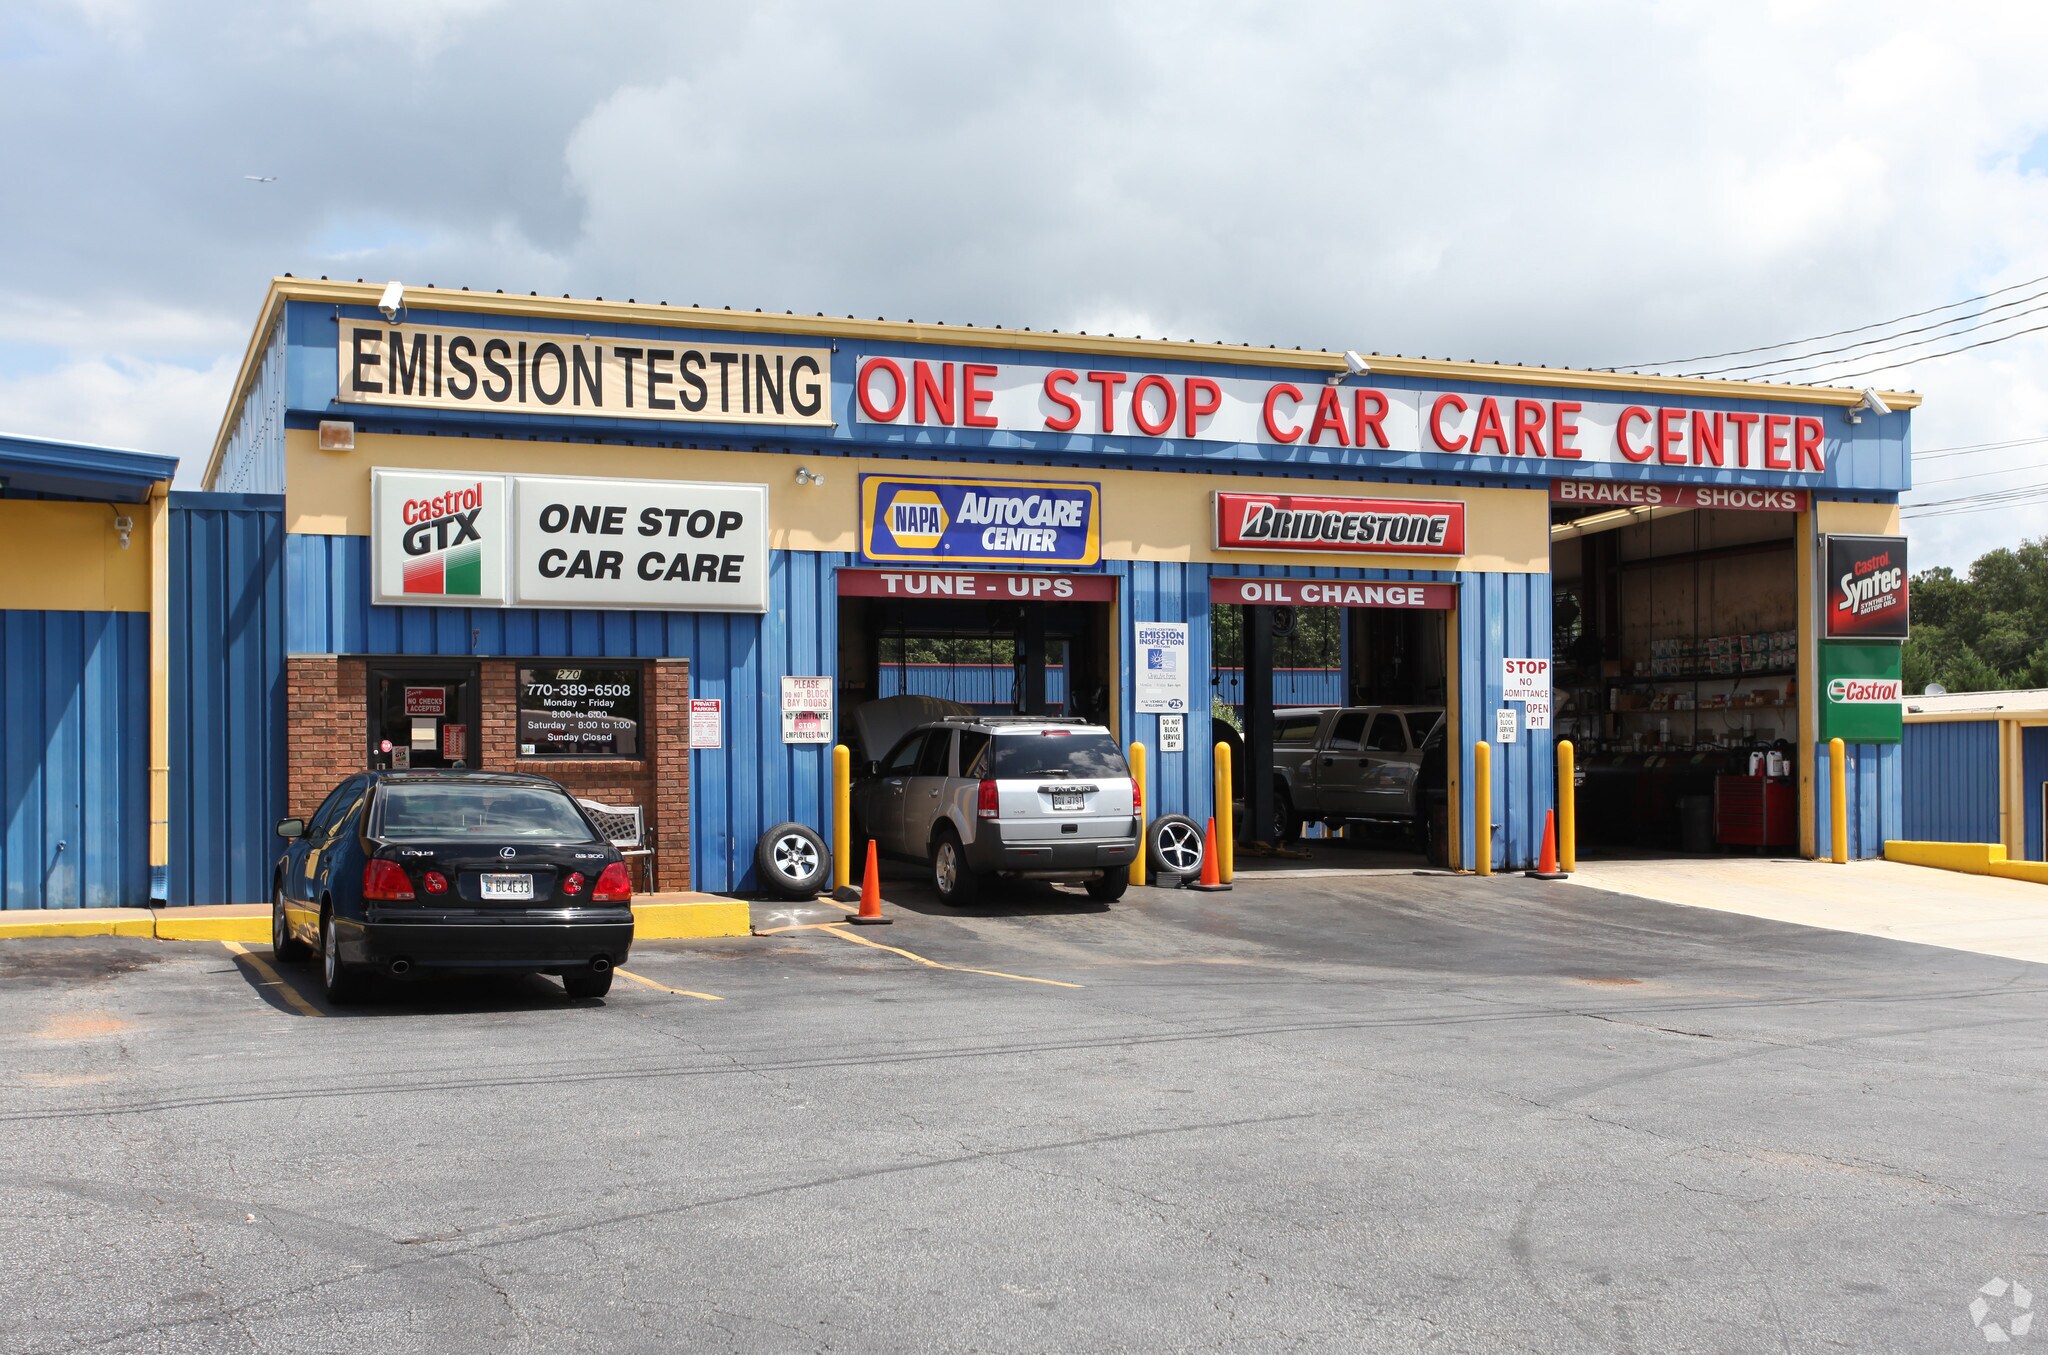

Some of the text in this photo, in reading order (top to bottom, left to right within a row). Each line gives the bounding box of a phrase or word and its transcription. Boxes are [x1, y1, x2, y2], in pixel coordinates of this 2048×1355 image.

[352, 328, 822, 417] EMISSION TESTING
[857, 356, 1825, 471] ONE STOP CAR CARE CENTER
[1560, 481, 1662, 503] BRAKES
[1696, 488, 1796, 509] SHOCKS
[403, 482, 482, 526] Castrol
[539, 503, 743, 538] ONE STOP
[895, 506, 940, 533] NAPA
[402, 508, 482, 556] GTX
[981, 527, 1057, 552] CENTER
[538, 548, 744, 583] CAR CARE
[1854, 551, 1889, 576] Castrol
[881, 573, 976, 595] TUNE
[1008, 577, 1074, 598] UPS
[1839, 567, 1901, 614] Syntec
[1241, 583, 1425, 605] OIL CHANGE
[1860, 594, 1893, 610] SYNTHETIC
[1860, 598, 1896, 616] MOTOR OILS
[1139, 630, 1185, 640] EMISSION
[1139, 638, 1185, 646] INSPECTION
[557, 669, 580, 679] 270
[1505, 660, 1548, 674] STOP
[793, 679, 820, 689] PLEASE
[1519, 678, 1533, 686] NO
[527, 683, 631, 697] 770-389-6508
[806, 689, 829, 698] BLOCK
[1504, 689, 1549, 698] ADMITTANCE
[1846, 681, 1898, 701] Castrol
[543, 698, 577, 708] Monday
[588, 698, 615, 708] Friday
[787, 698, 828, 707] BAY DOORS
[1526, 703, 1549, 714] OPEN
[551, 710, 572, 719] 8:00
[575, 710, 584, 719] to
[785, 712, 829, 720] NO ADMITTANCE
[1530, 716, 1545, 726] PIT
[527, 721, 566, 731] Saturday
[578, 721, 598, 730] 8:00
[601, 721, 610, 730] to
[614, 721, 631, 730] 1:00
[547, 732, 612, 743] Sunday Closed
[495, 879, 531, 893] BC4E33
